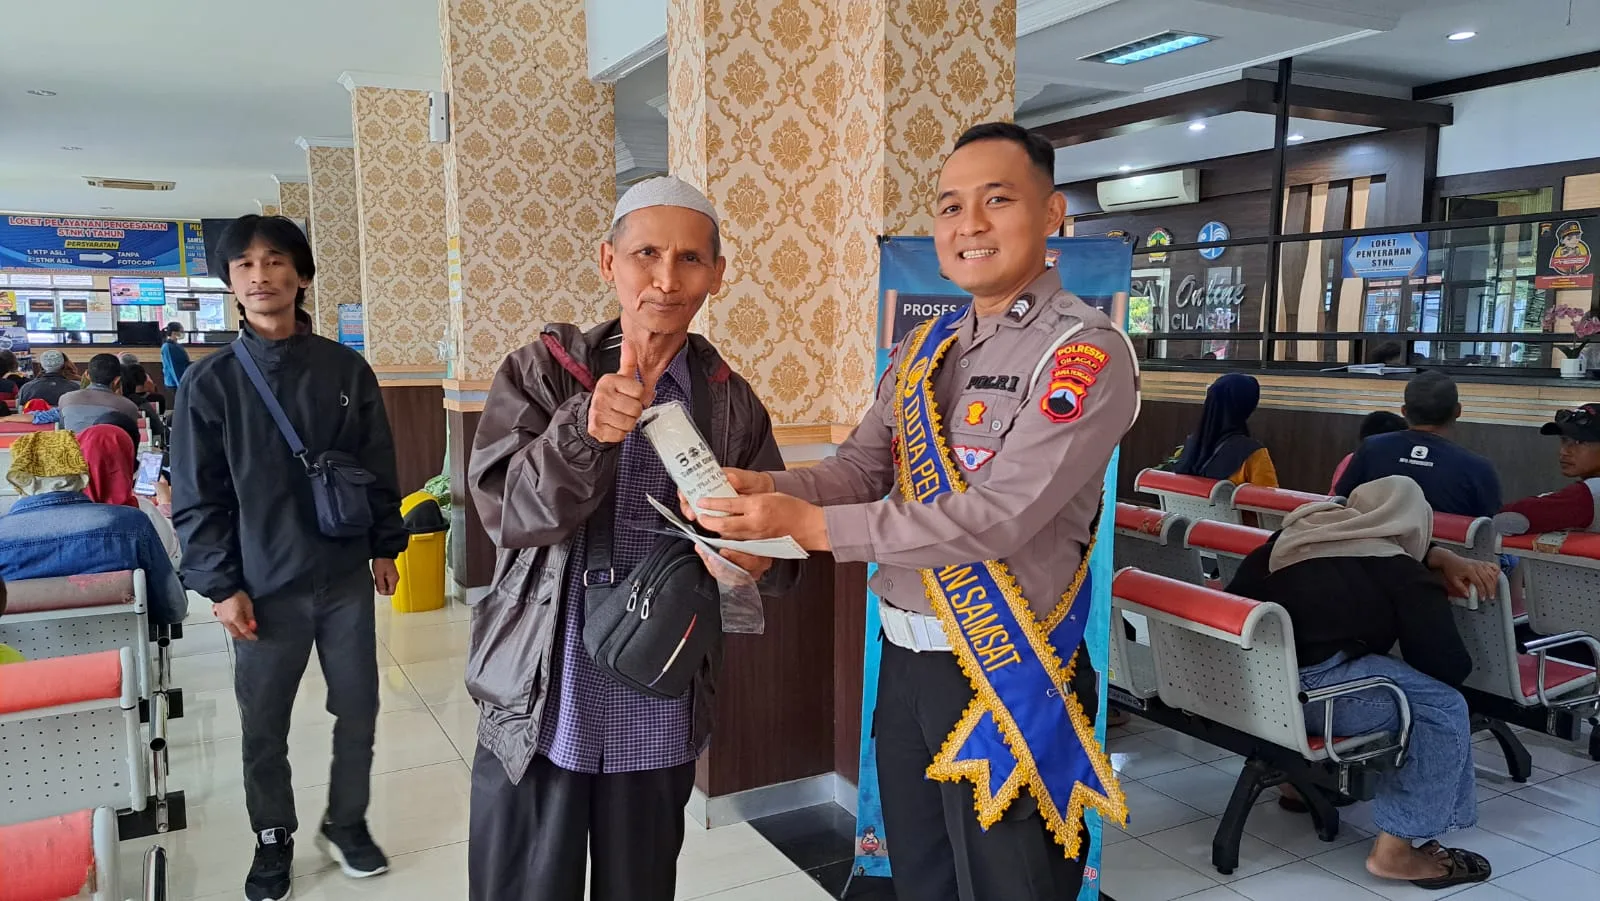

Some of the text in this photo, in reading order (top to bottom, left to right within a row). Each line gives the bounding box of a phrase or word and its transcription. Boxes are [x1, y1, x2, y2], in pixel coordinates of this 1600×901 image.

[9, 216, 168, 231] LOKET PELAYANAN PENGESAHAN
[57, 228, 84, 237] STNK
[92, 230, 124, 238] TAHUN
[66, 240, 117, 249] PERSYARATAN
[1371, 238, 1397, 248] LOKET
[1356, 247, 1412, 259] PENYERAHAN
[1371, 258, 1394, 267] STNK
[1175, 274, 1247, 308] Online
[903, 303, 957, 316] PROSES
[1171, 312, 1236, 331] CILACAP
[1057, 344, 1107, 363] POLRESTA
[965, 375, 1020, 392] POLRI
[904, 395, 940, 503] DUTA PEL
[950, 585, 1022, 673] SAMSAT
